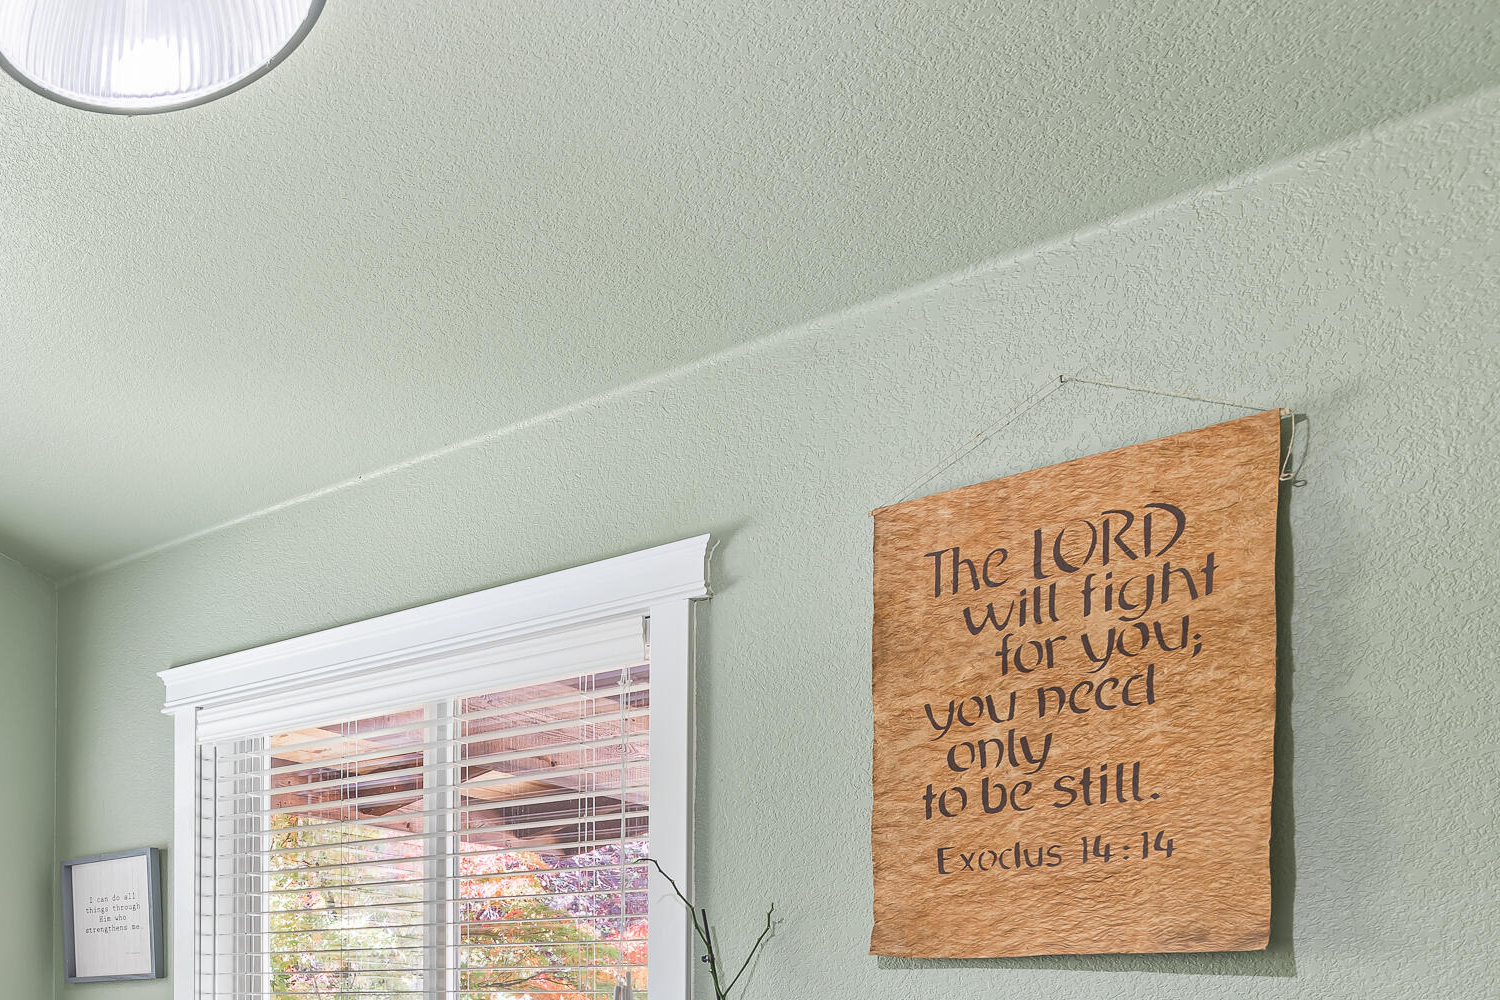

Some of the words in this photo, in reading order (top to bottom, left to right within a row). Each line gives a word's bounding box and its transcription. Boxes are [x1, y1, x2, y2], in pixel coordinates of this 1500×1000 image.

[924, 546, 1009, 598] The
[1034, 503, 1187, 580] LORD
[962, 583, 1060, 635] will
[1082, 551, 1220, 622] fight
[994, 633, 1067, 676] for
[1080, 615, 1204, 674] you;
[924, 690, 1016, 741] you
[1038, 663, 1155, 719] need
[946, 728, 1053, 775] only
[922, 783, 968, 820] to
[981, 776, 1032, 815] be
[1053, 760, 1161, 808] still.
[936, 843, 1063, 874] Exodus
[1081, 830, 1177, 865] 14:14
[85, 906, 109, 914] things
[112, 903, 141, 912] through
[124, 892, 136, 900] all
[85, 926, 128, 934] strengthens
